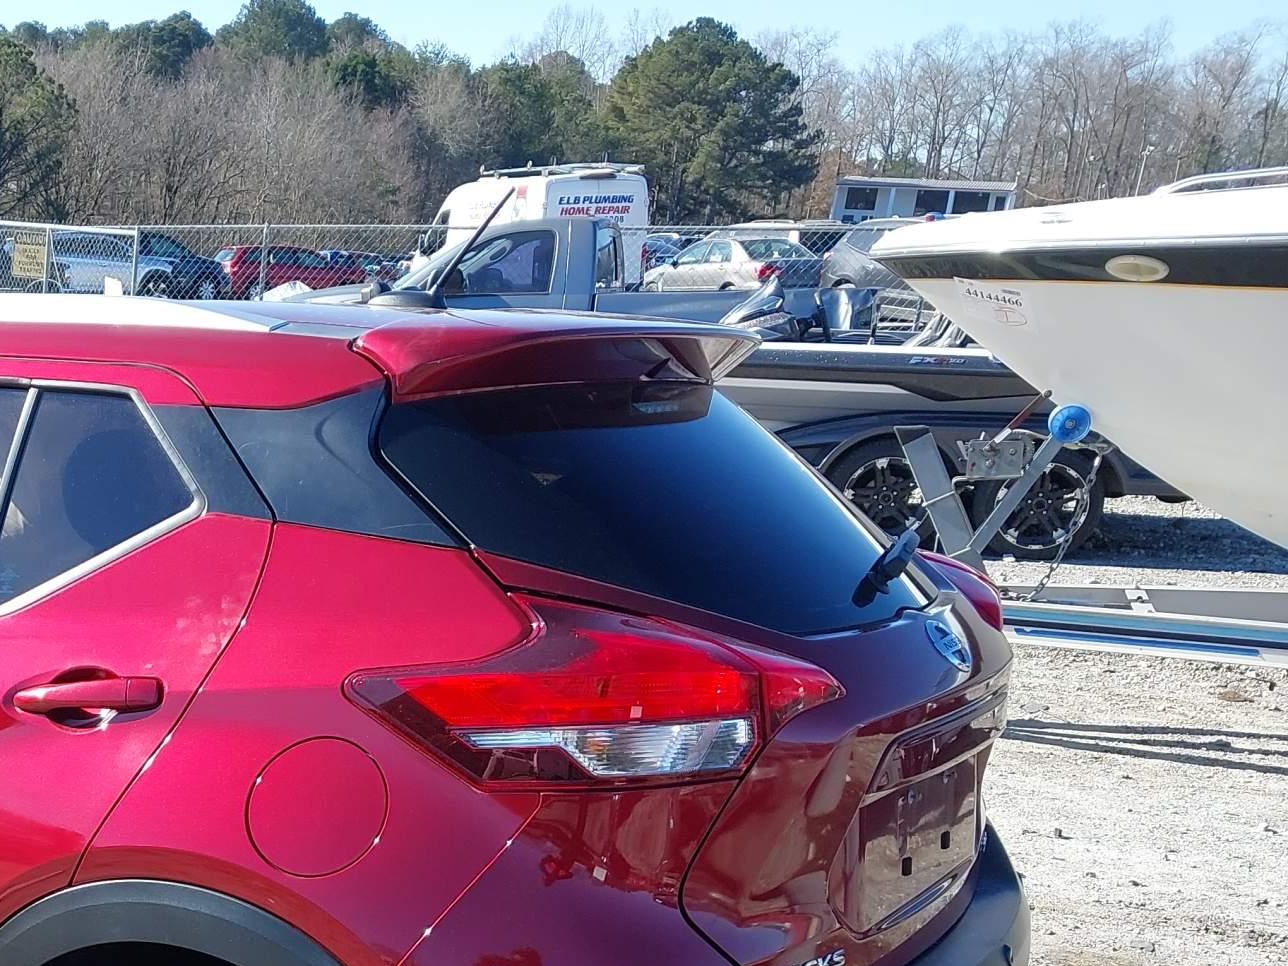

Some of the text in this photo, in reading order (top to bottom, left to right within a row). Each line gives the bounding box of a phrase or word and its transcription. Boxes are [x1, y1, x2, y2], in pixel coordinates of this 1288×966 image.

[582, 194, 634, 205] PLUMBING
[560, 205, 631, 216] HOME REPAIR
[965, 287, 1023, 307] 44144466
